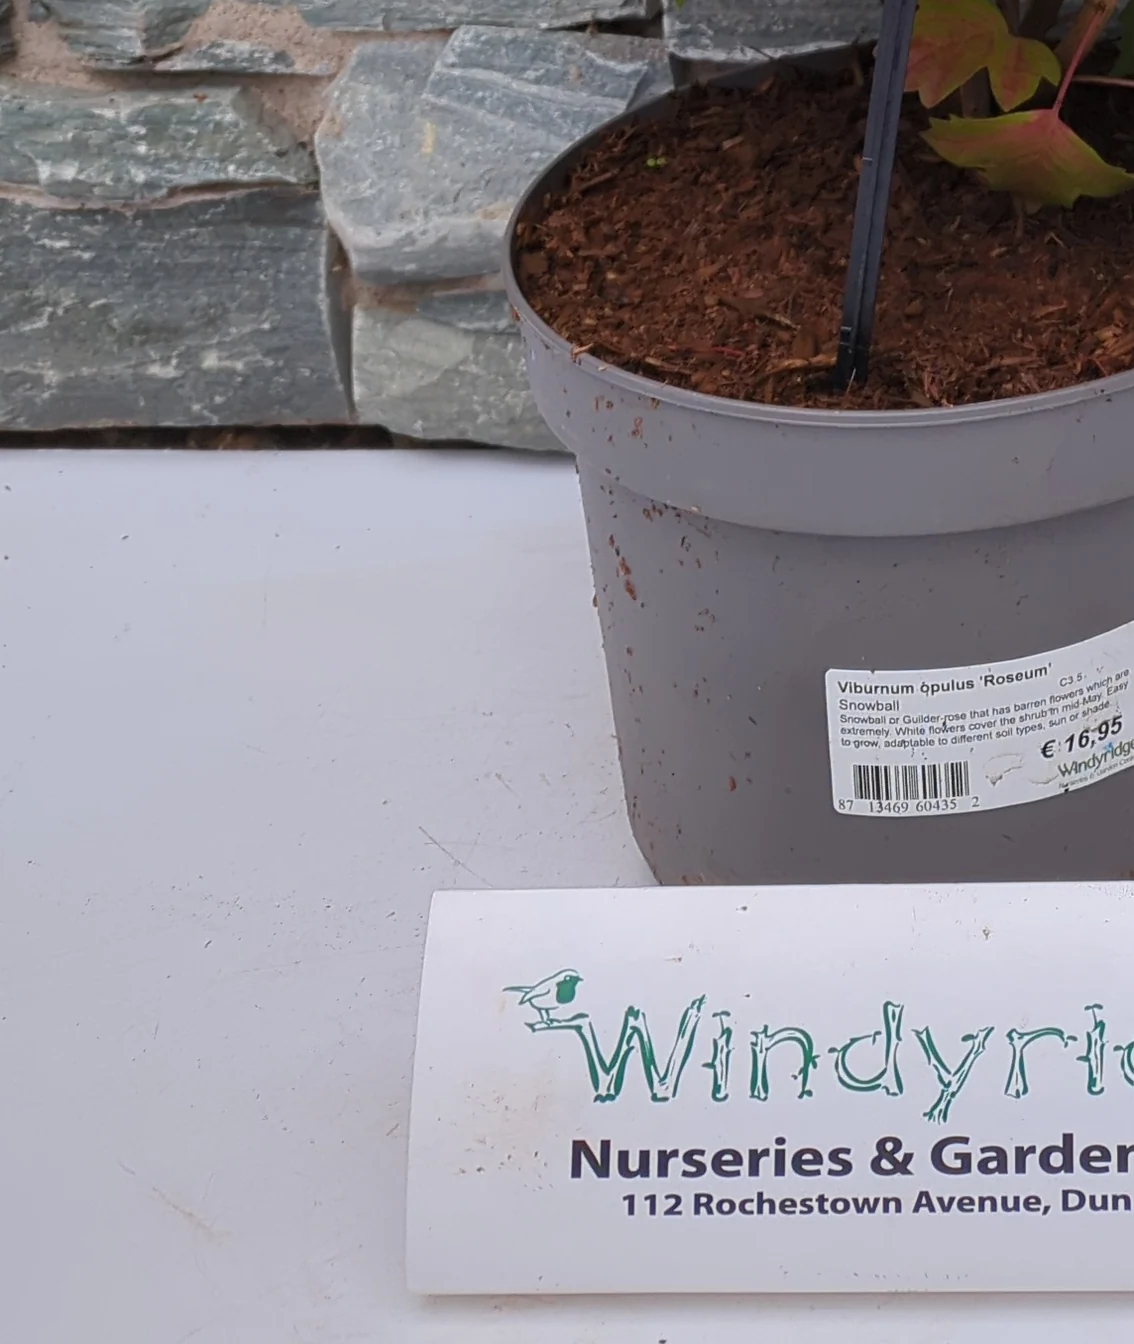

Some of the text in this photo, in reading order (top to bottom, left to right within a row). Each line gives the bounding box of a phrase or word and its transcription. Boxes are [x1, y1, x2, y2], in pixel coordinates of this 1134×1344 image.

[838, 662, 1053, 696] Viburnum opulus 'Roseum'
[840, 668, 1130, 725] Snowball or Guilder-rose that has barren flowers which are
[839, 699, 900, 711] Snowball
[895, 726, 926, 736] White
[928, 722, 966, 734] flowers
[969, 720, 996, 732] cover
[1000, 715, 1016, 726] the
[1018, 708, 1047, 722] shrub
[1106, 681, 1129, 697] Easy
[841, 737, 850, 747] to
[884, 735, 935, 748] adaptable
[938, 735, 948, 745] to
[951, 731, 993, 745] different
[995, 727, 1013, 739] soil
[1016, 721, 1046, 737] types,
[1049, 717, 1067, 728] sun
[1069, 712, 1080, 722] or
[1041, 714, 1123, 759] € 16,95
[838, 796, 980, 813] 87 13469 60435 2
[570, 1137, 853, 1179] Nurseries
[870, 1135, 914, 1176] &
[621, 1193, 683, 1217] 112
[693, 1191, 901, 1216] Rochestown
[912, 1188, 1051, 1216] Avenue,
[1061, 1188, 1132, 1212] Dun
